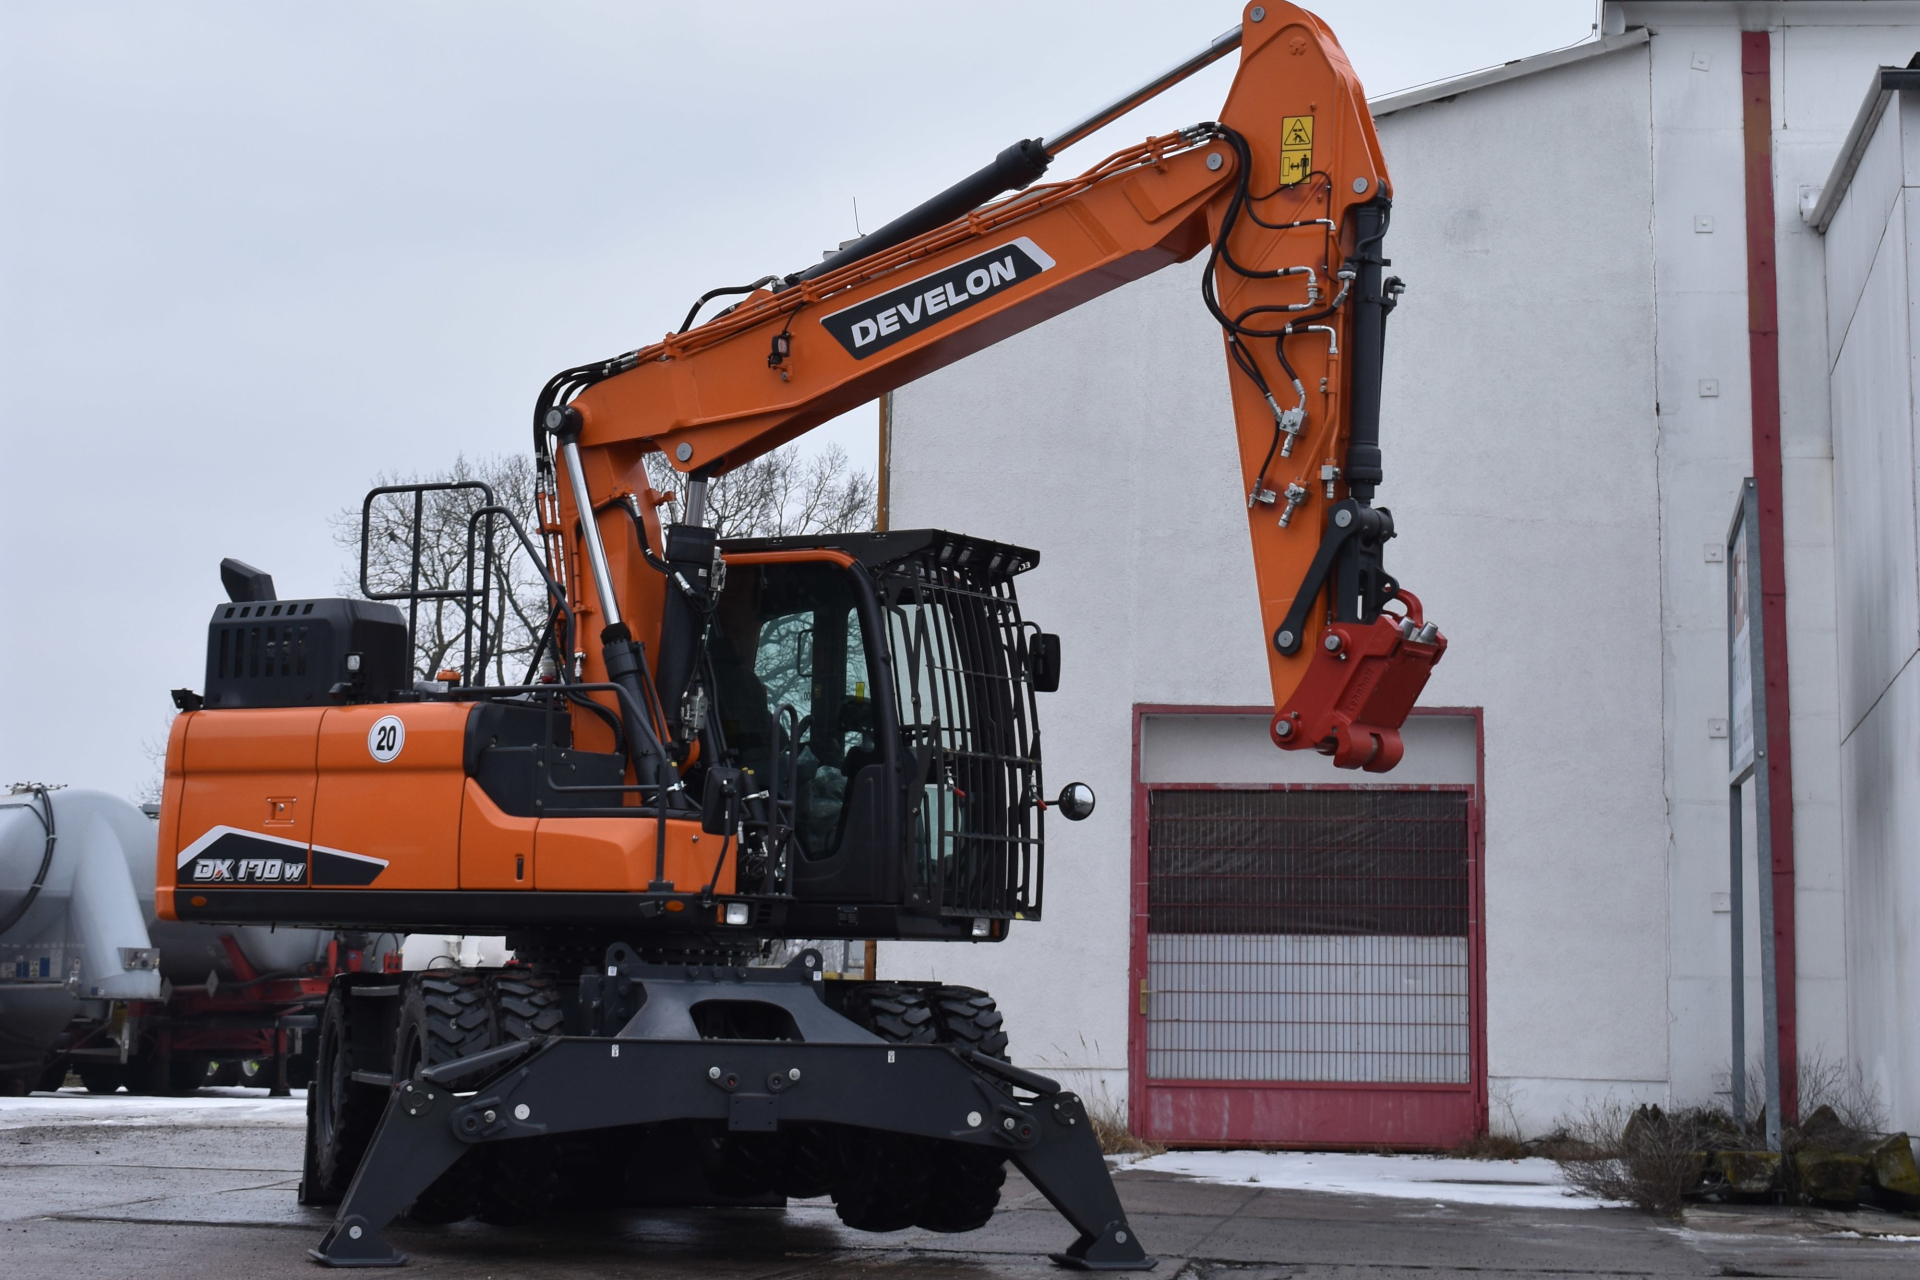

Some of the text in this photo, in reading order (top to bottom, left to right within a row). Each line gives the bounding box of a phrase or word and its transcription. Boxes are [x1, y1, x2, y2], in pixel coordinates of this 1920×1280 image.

[851, 255, 1017, 348] DEVELON
[376, 725, 397, 752] 20
[193, 859, 234, 881] DX
